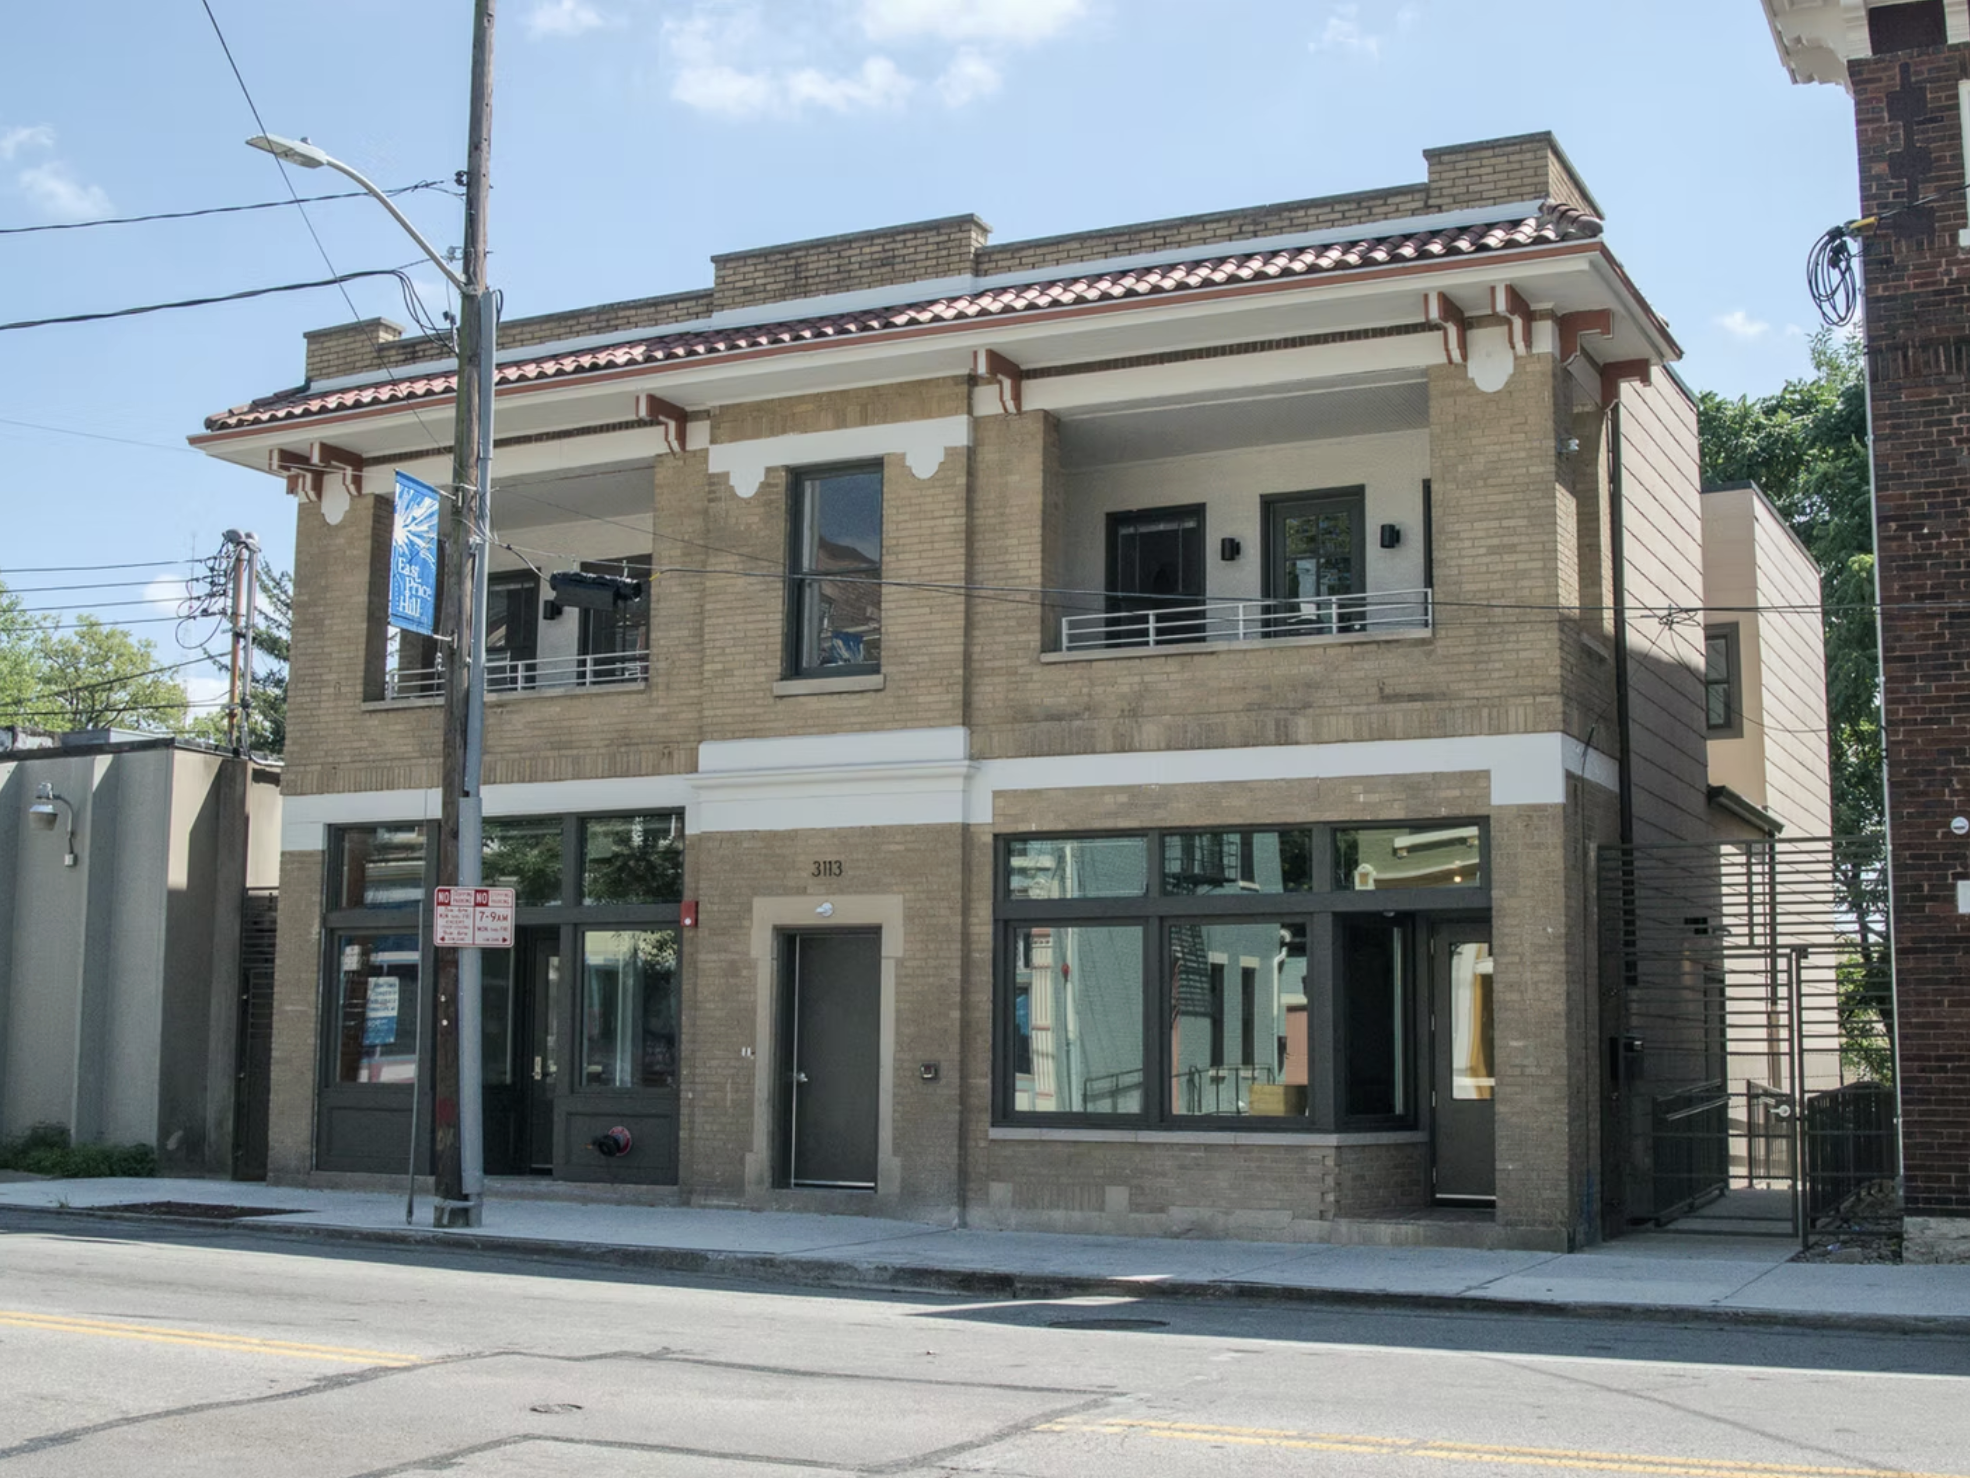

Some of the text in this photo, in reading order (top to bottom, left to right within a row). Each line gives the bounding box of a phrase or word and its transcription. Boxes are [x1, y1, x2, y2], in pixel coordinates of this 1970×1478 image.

[398, 557, 421, 582] East
[405, 577, 431, 600] Price
[398, 592, 420, 617] Hill
[811, 859, 843, 878] 3113
[438, 891, 450, 904] NO
[476, 892, 488, 904] NO
